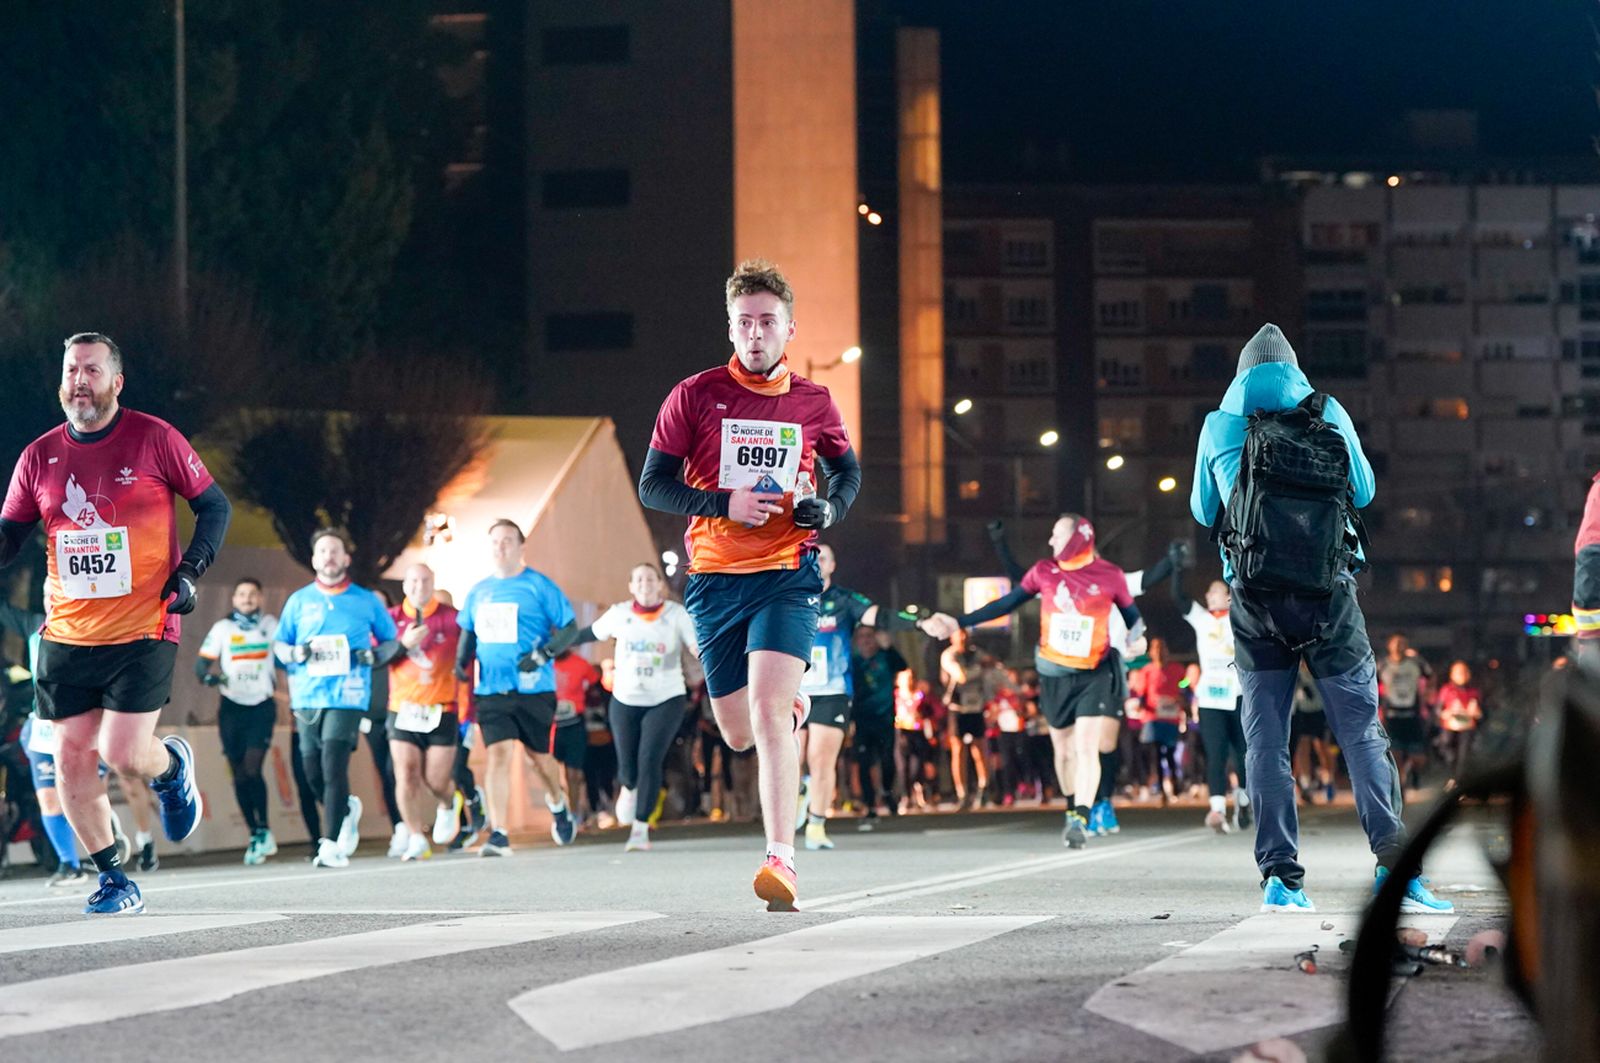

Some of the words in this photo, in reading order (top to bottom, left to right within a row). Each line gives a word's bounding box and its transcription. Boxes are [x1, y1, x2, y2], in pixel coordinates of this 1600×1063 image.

[740, 428, 764, 437] NOCHE
[765, 429, 774, 437] DE
[731, 436, 746, 445] SAN
[737, 445, 788, 468] 6997
[77, 508, 96, 527] 43
[90, 536, 99, 544] DE
[64, 546, 76, 554] SAN
[69, 553, 117, 575] 6452
